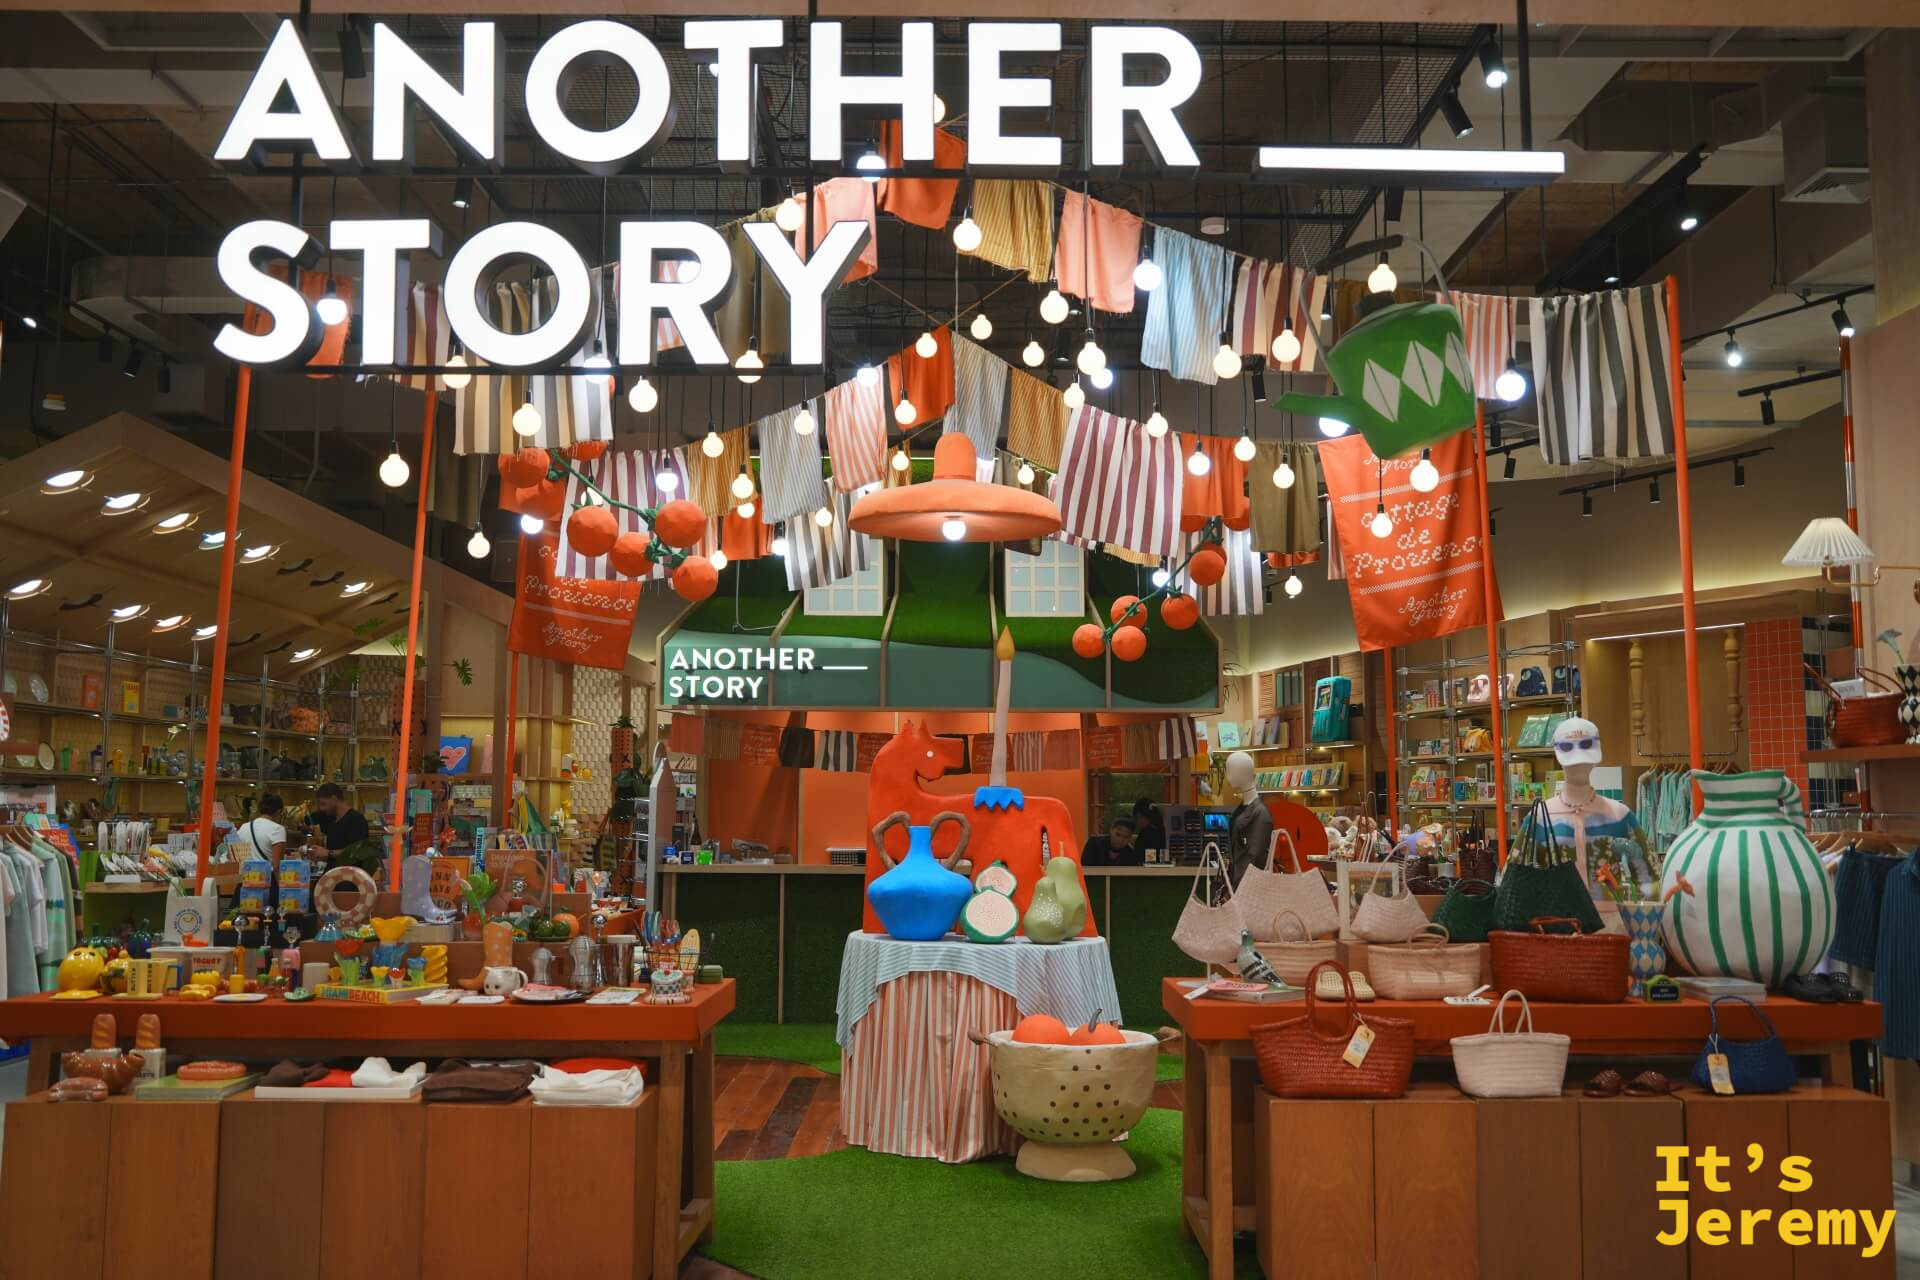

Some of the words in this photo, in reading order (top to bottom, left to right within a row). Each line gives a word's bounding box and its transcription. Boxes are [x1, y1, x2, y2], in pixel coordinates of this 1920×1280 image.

[213, 18, 1202, 168] ANOTHER
[213, 219, 870, 367] STORY
[1376, 455, 1417, 478] Stor
[1361, 493, 1459, 528] cttage
[1397, 527, 1431, 549] de
[670, 648, 815, 671] ANOTHER
[669, 675, 763, 699] STORY
